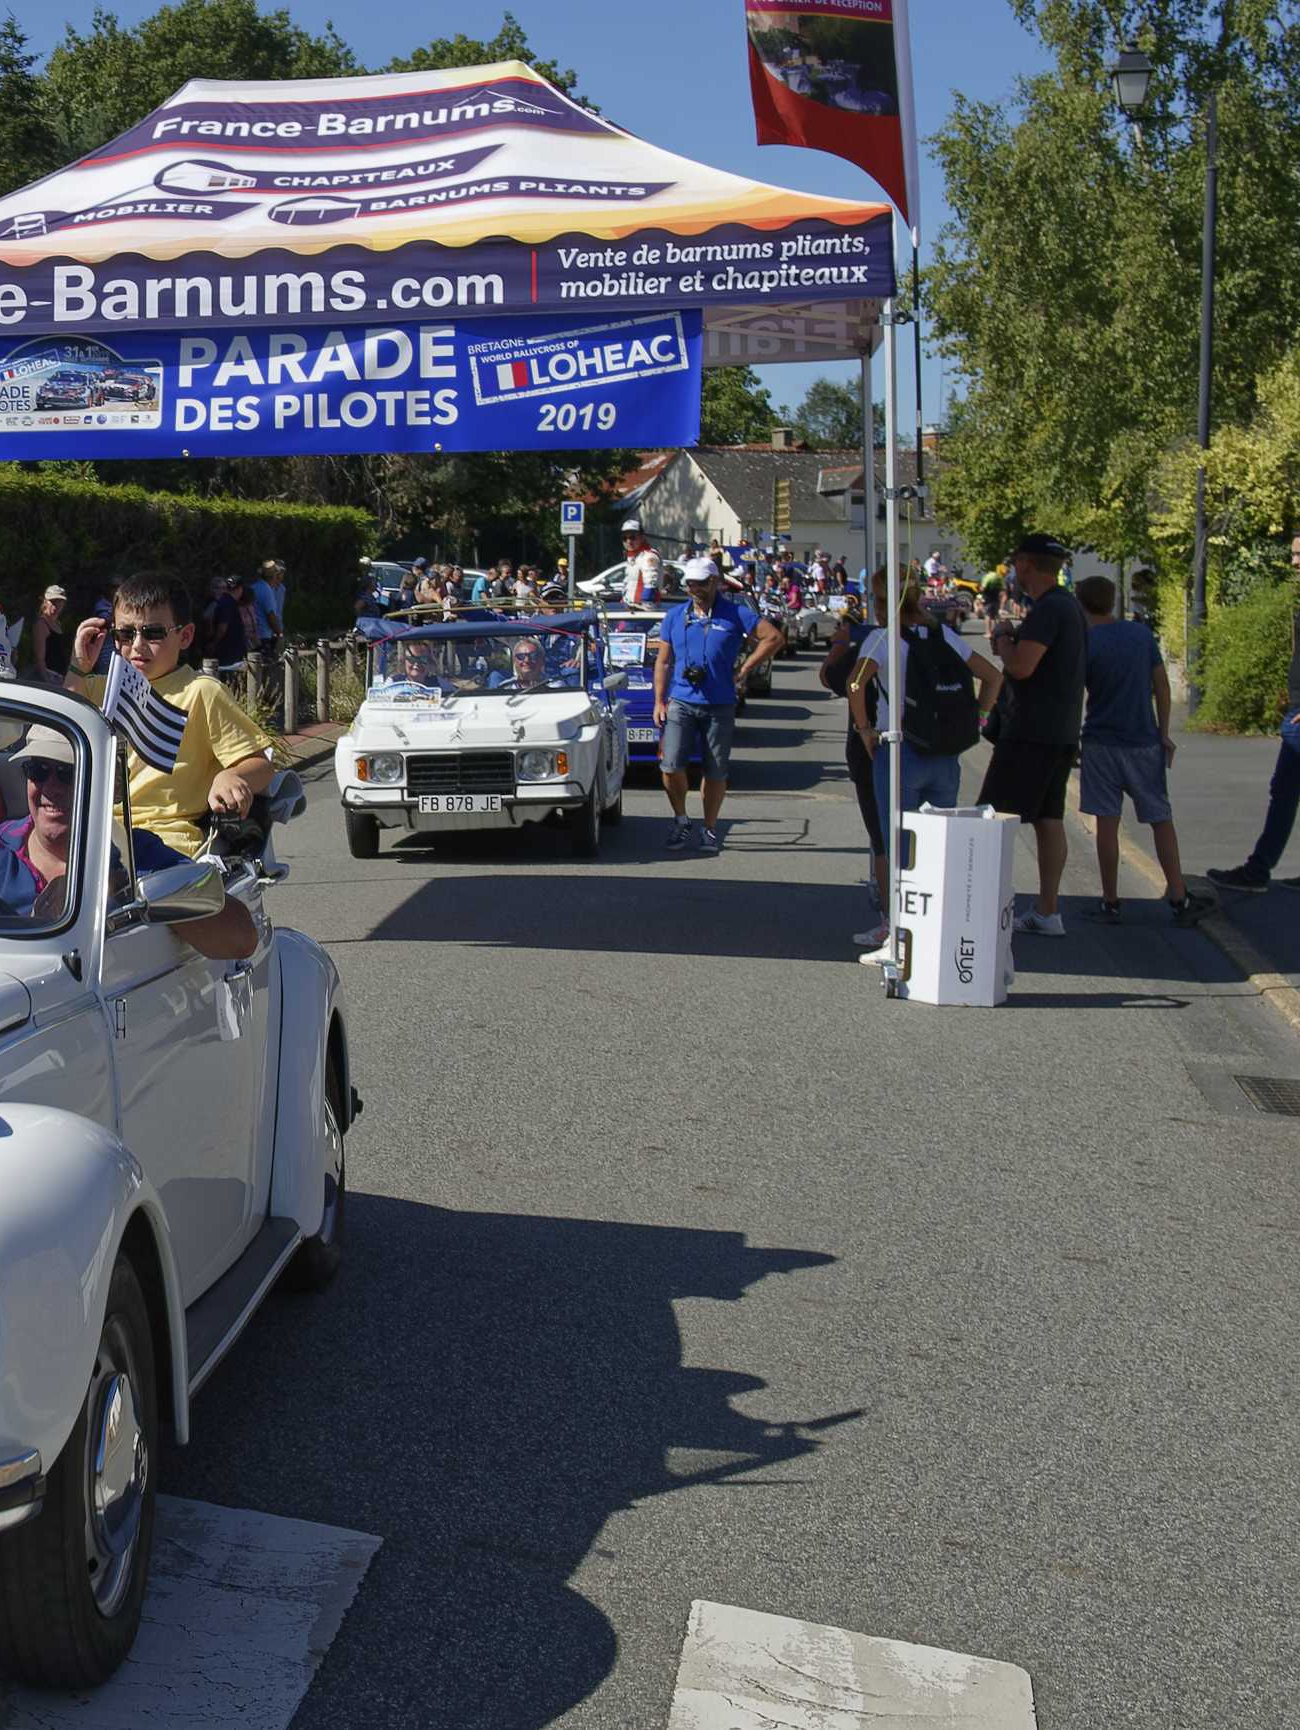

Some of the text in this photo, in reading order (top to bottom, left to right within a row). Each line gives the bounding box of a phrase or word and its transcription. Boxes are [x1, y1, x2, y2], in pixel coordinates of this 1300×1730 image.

[273, 158, 455, 188] CHAPITEAUX
[369, 180, 646, 211] BARNUMS PLIANTS
[73, 203, 214, 223] MOBILIER
[557, 232, 871, 269] Vente de barnums pliants,
[560, 264, 868, 300] mobilier et chapiteaux
[178, 325, 457, 387] PARADE
[467, 338, 525, 355] BRETAGNE
[480, 340, 579, 363] WORLD RALLYCROSS OF
[529, 335, 675, 385] LOHEAC
[14, 357, 58, 377] LOHEAC
[175, 388, 459, 432] DES PILOTES
[536, 402, 617, 432] 2019
[567, 506, 577, 519] P
[421, 795, 500, 812] FB 878 JE
